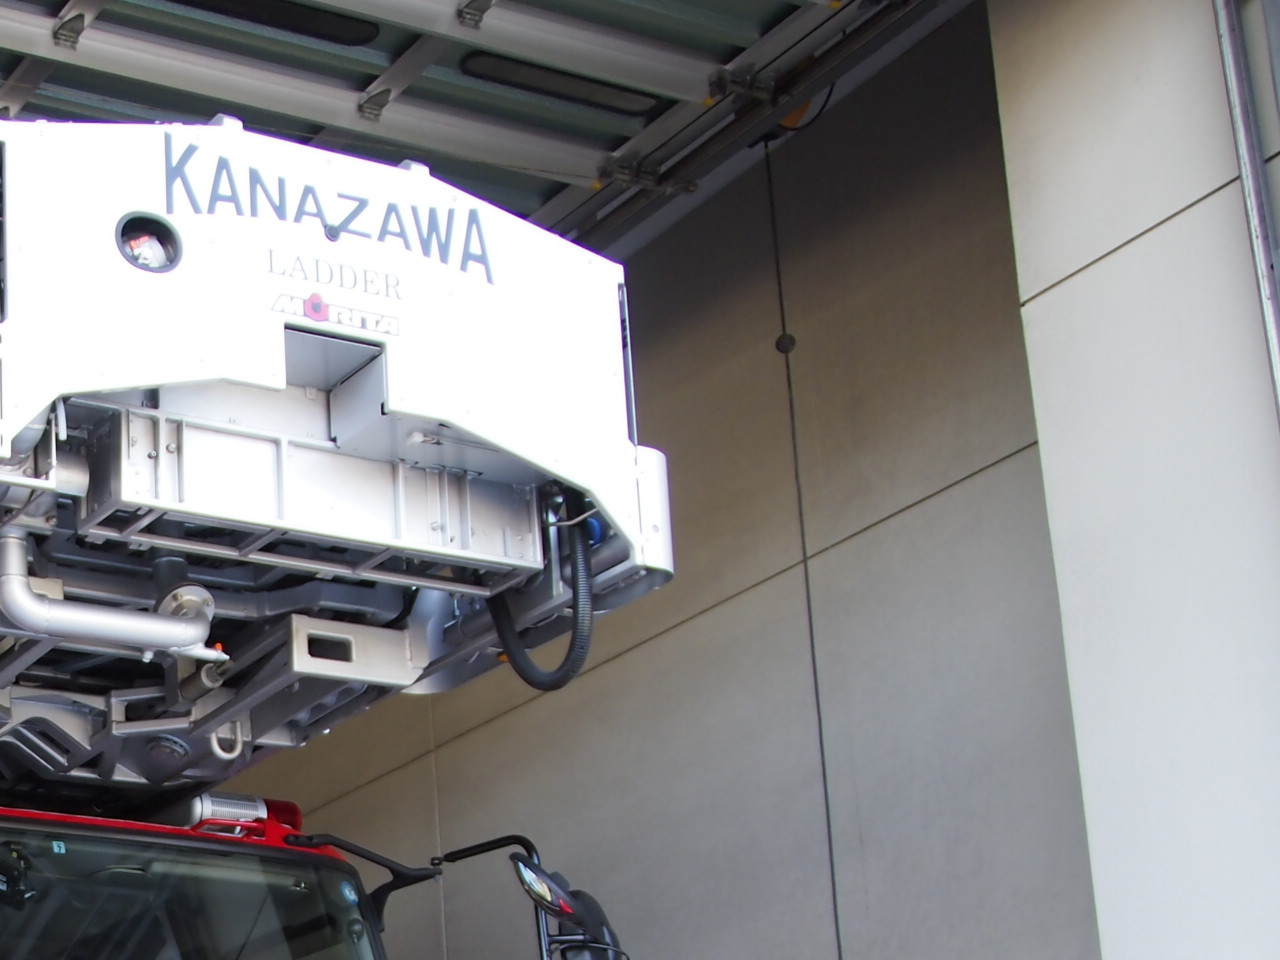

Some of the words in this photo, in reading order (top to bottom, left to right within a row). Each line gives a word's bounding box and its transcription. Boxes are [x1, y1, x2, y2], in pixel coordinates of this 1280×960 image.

[164, 131, 494, 285] KANAZAWA
[267, 248, 403, 300] LADDER
[271, 293, 400, 336] MORITA
